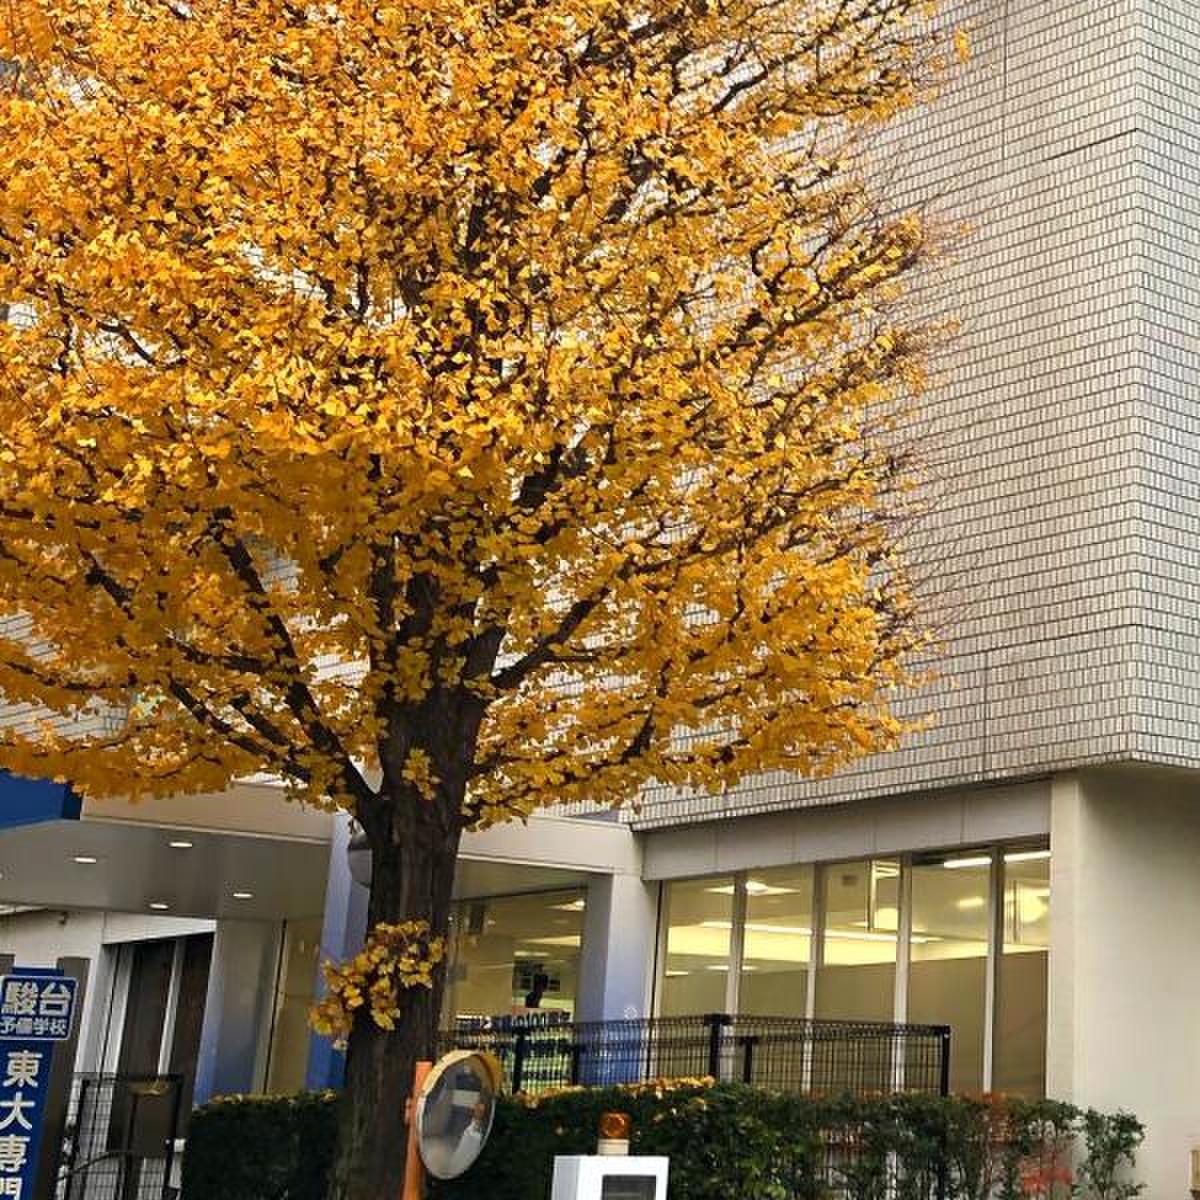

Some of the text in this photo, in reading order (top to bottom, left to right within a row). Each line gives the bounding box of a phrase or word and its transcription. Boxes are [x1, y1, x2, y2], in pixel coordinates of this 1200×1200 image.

[2, 981, 72, 1016] 駿台
[0, 1017, 67, 1036] 予備学校
